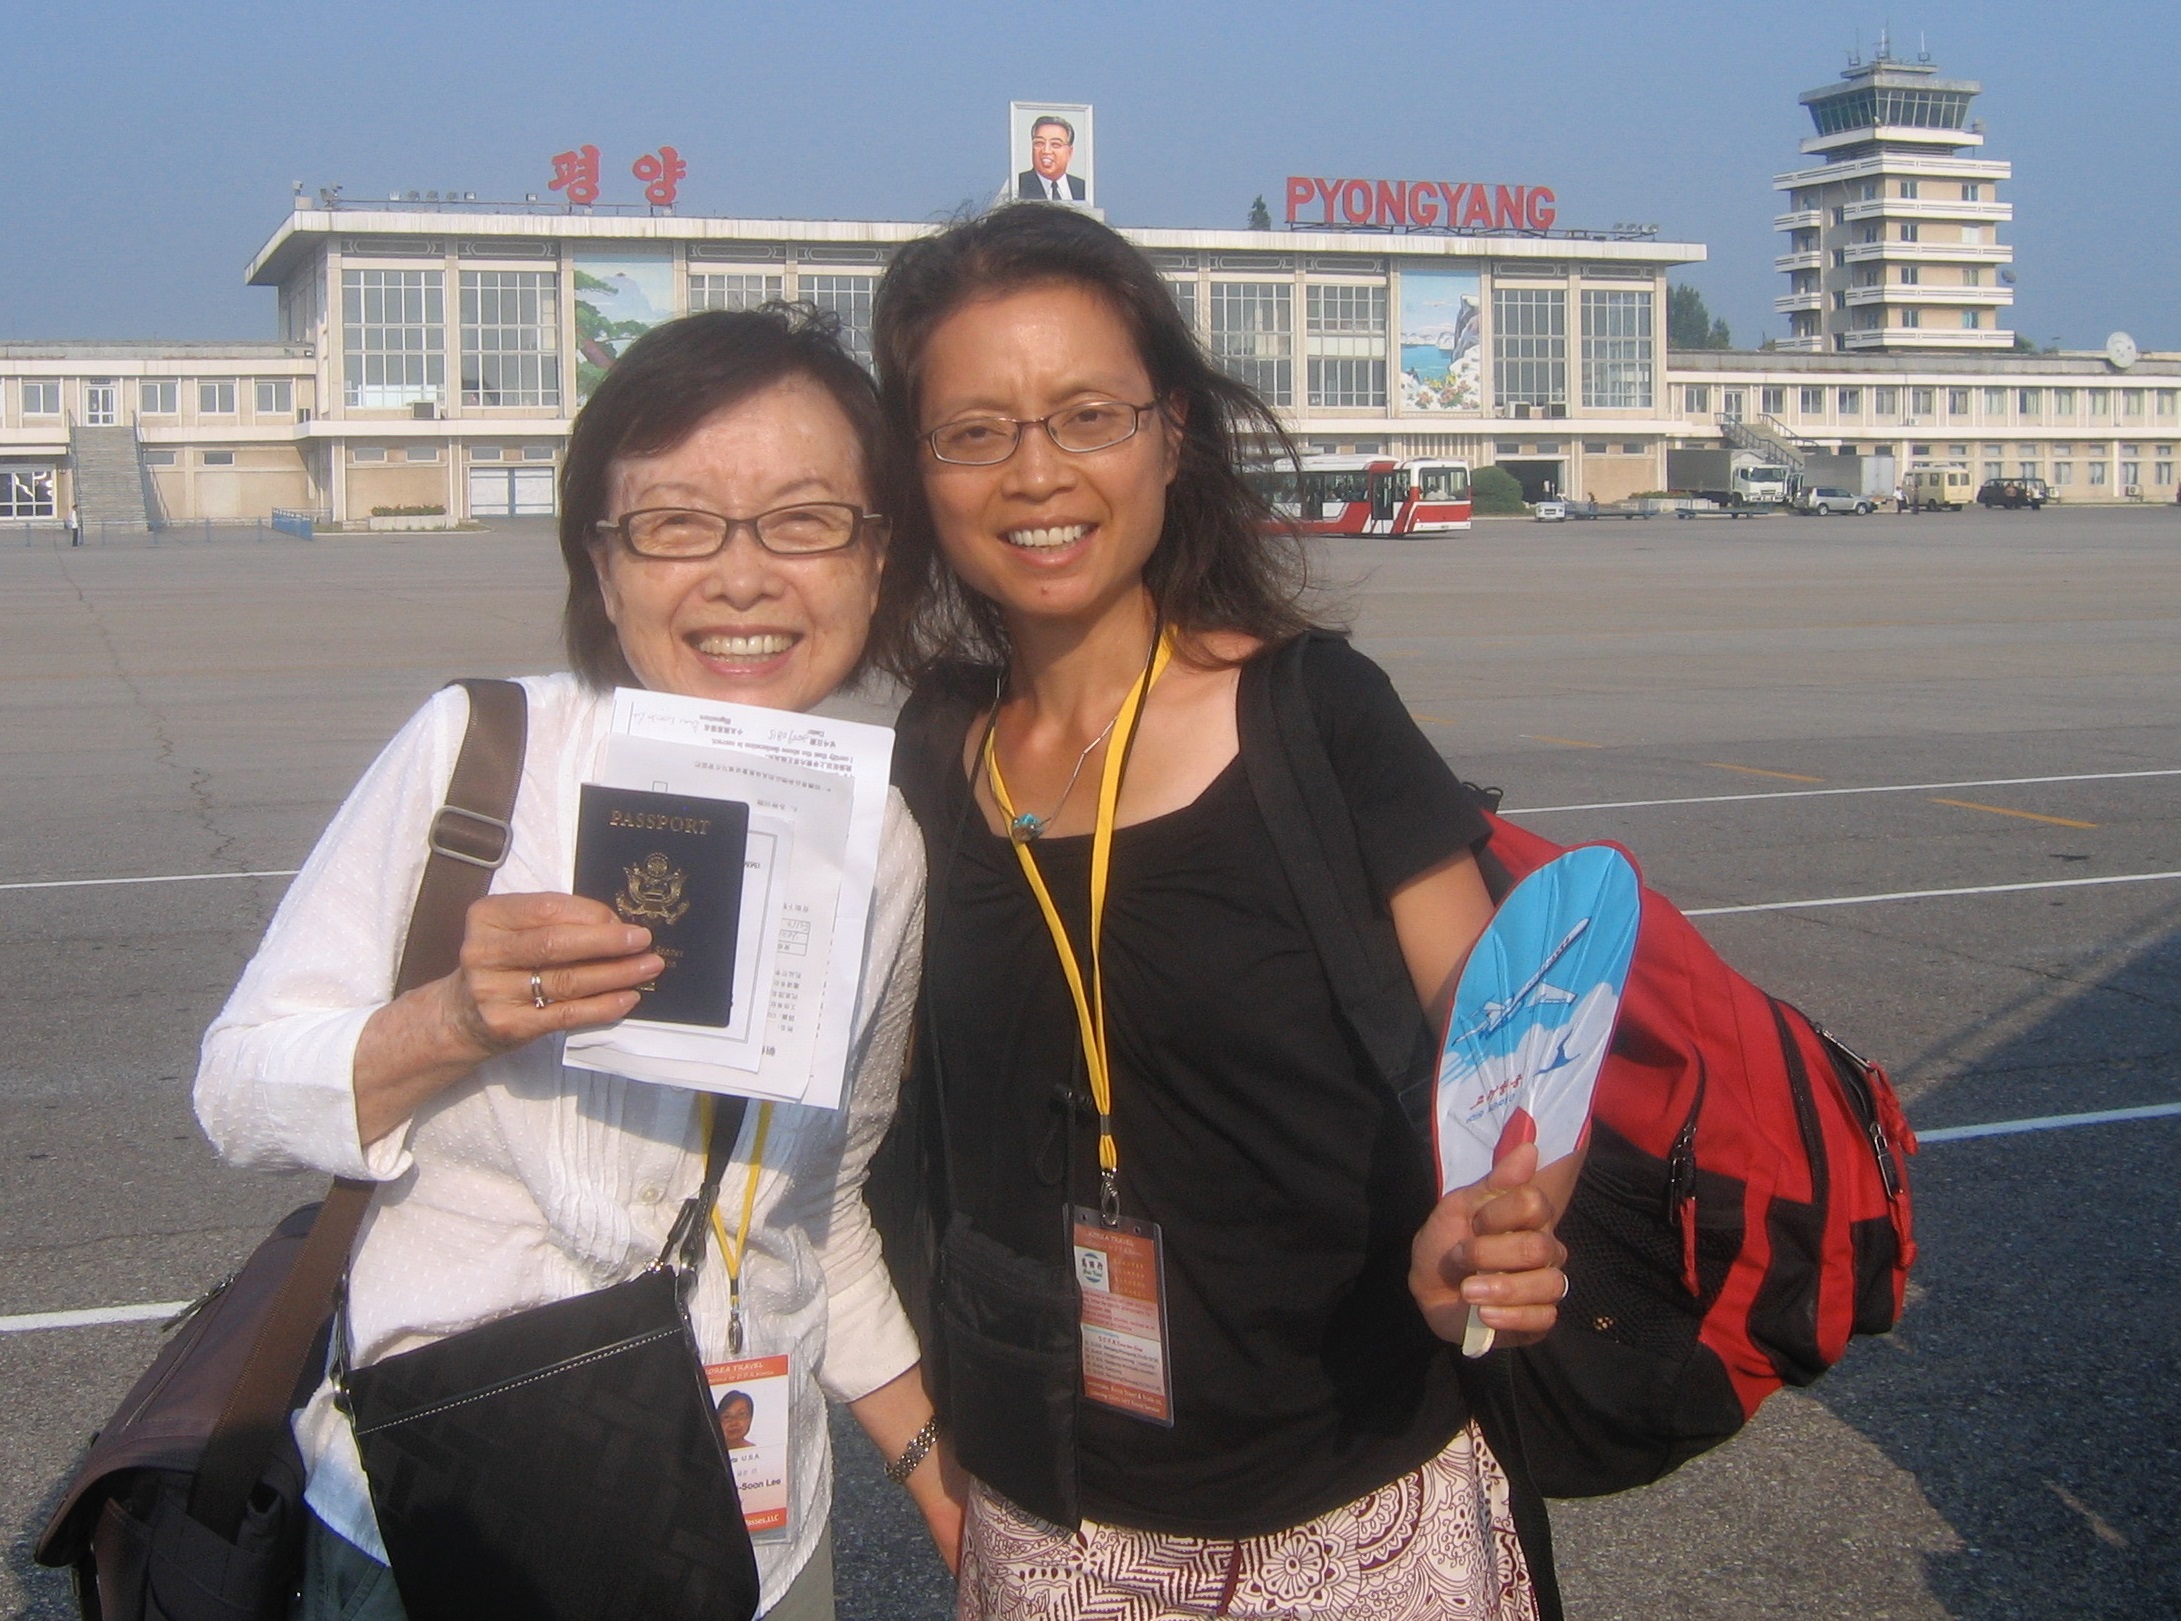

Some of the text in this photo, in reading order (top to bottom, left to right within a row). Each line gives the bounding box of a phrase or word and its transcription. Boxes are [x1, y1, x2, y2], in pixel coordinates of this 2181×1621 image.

[548, 144, 688, 206] 평양
[1286, 176, 1557, 230] PYONGYANG
[609, 810, 711, 835] PASSPORT
[737, 1478, 782, 1491] -Soon Lee
